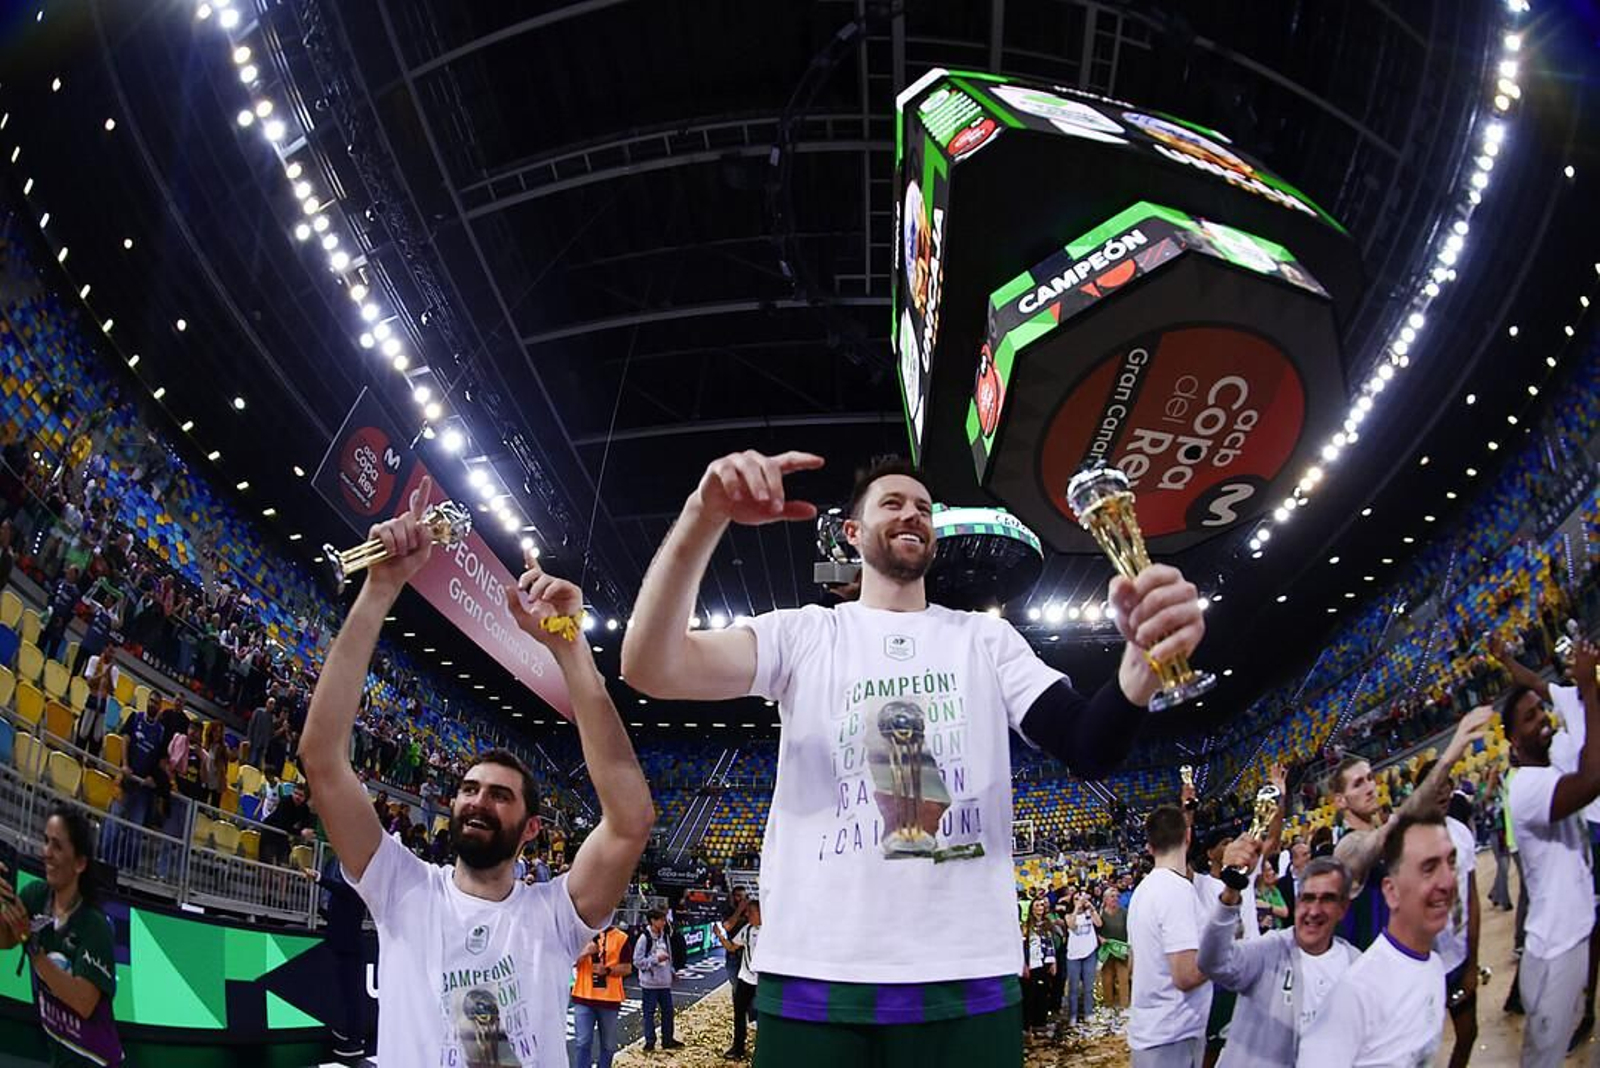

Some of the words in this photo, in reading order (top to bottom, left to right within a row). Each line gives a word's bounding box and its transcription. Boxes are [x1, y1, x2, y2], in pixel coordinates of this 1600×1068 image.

[1017, 229, 1149, 314] CAMPEÓN
[1114, 348, 1149, 401] Gran
[1162, 375, 1199, 424] del
[1115, 427, 1175, 489] Re
[1157, 375, 1248, 490] Copa
[1212, 409, 1258, 467] acb
[354, 448, 379, 482] Copa
[358, 472, 377, 499] Rey
[449, 577, 483, 622] Gran
[845, 668, 958, 712] ¡CAMPEÓN!
